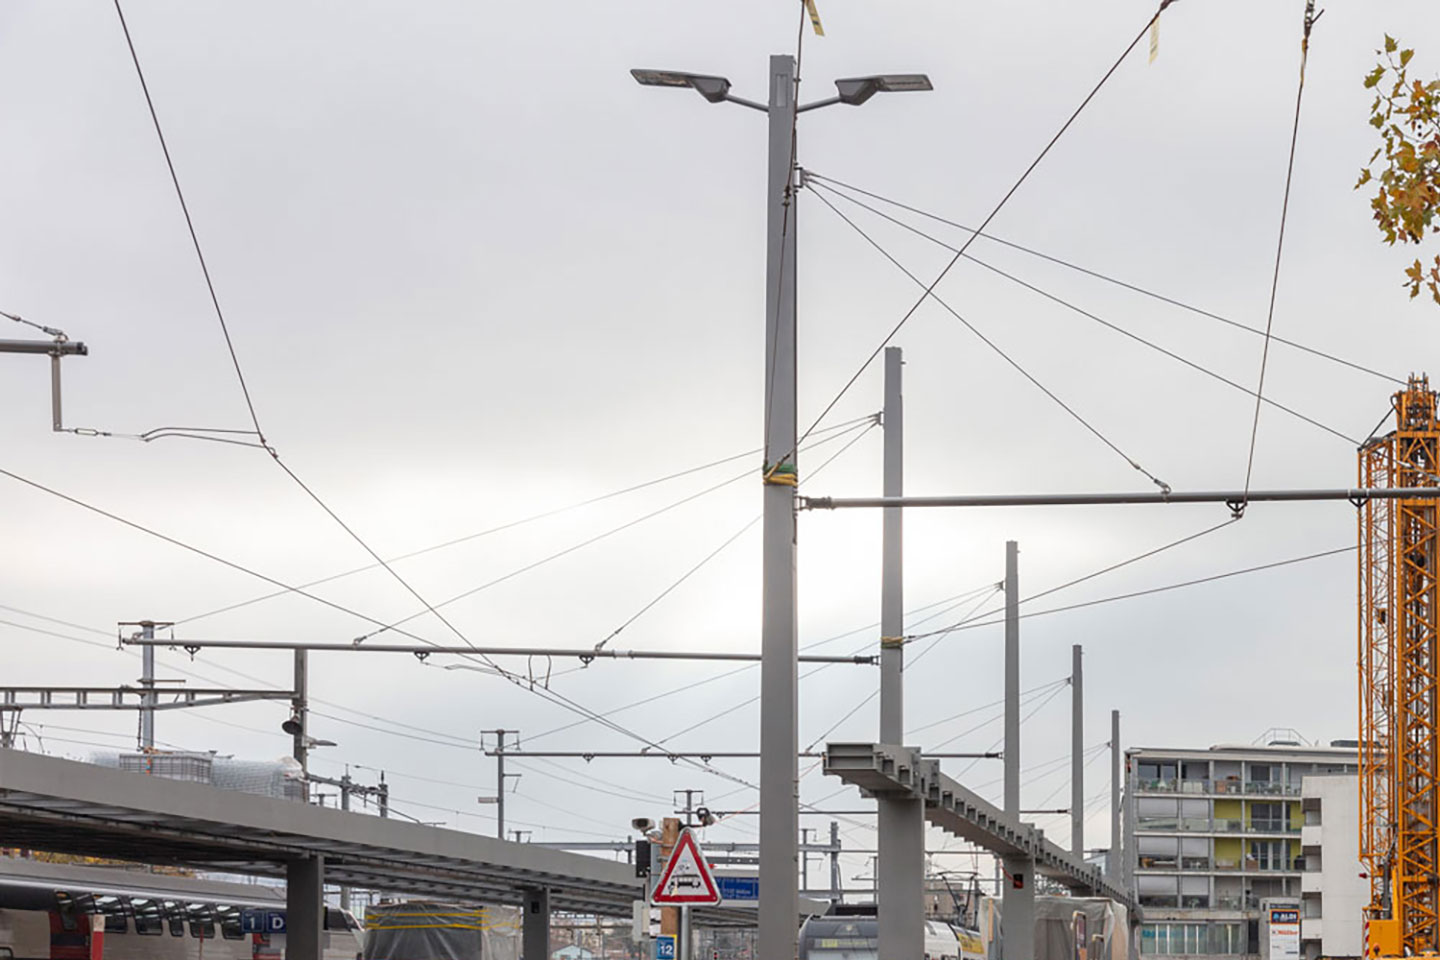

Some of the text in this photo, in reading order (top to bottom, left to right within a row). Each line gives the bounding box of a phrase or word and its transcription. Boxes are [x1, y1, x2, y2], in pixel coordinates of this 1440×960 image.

[249, 917, 255, 929] 1
[272, 917, 284, 929] D
[660, 944, 673, 955] 12
